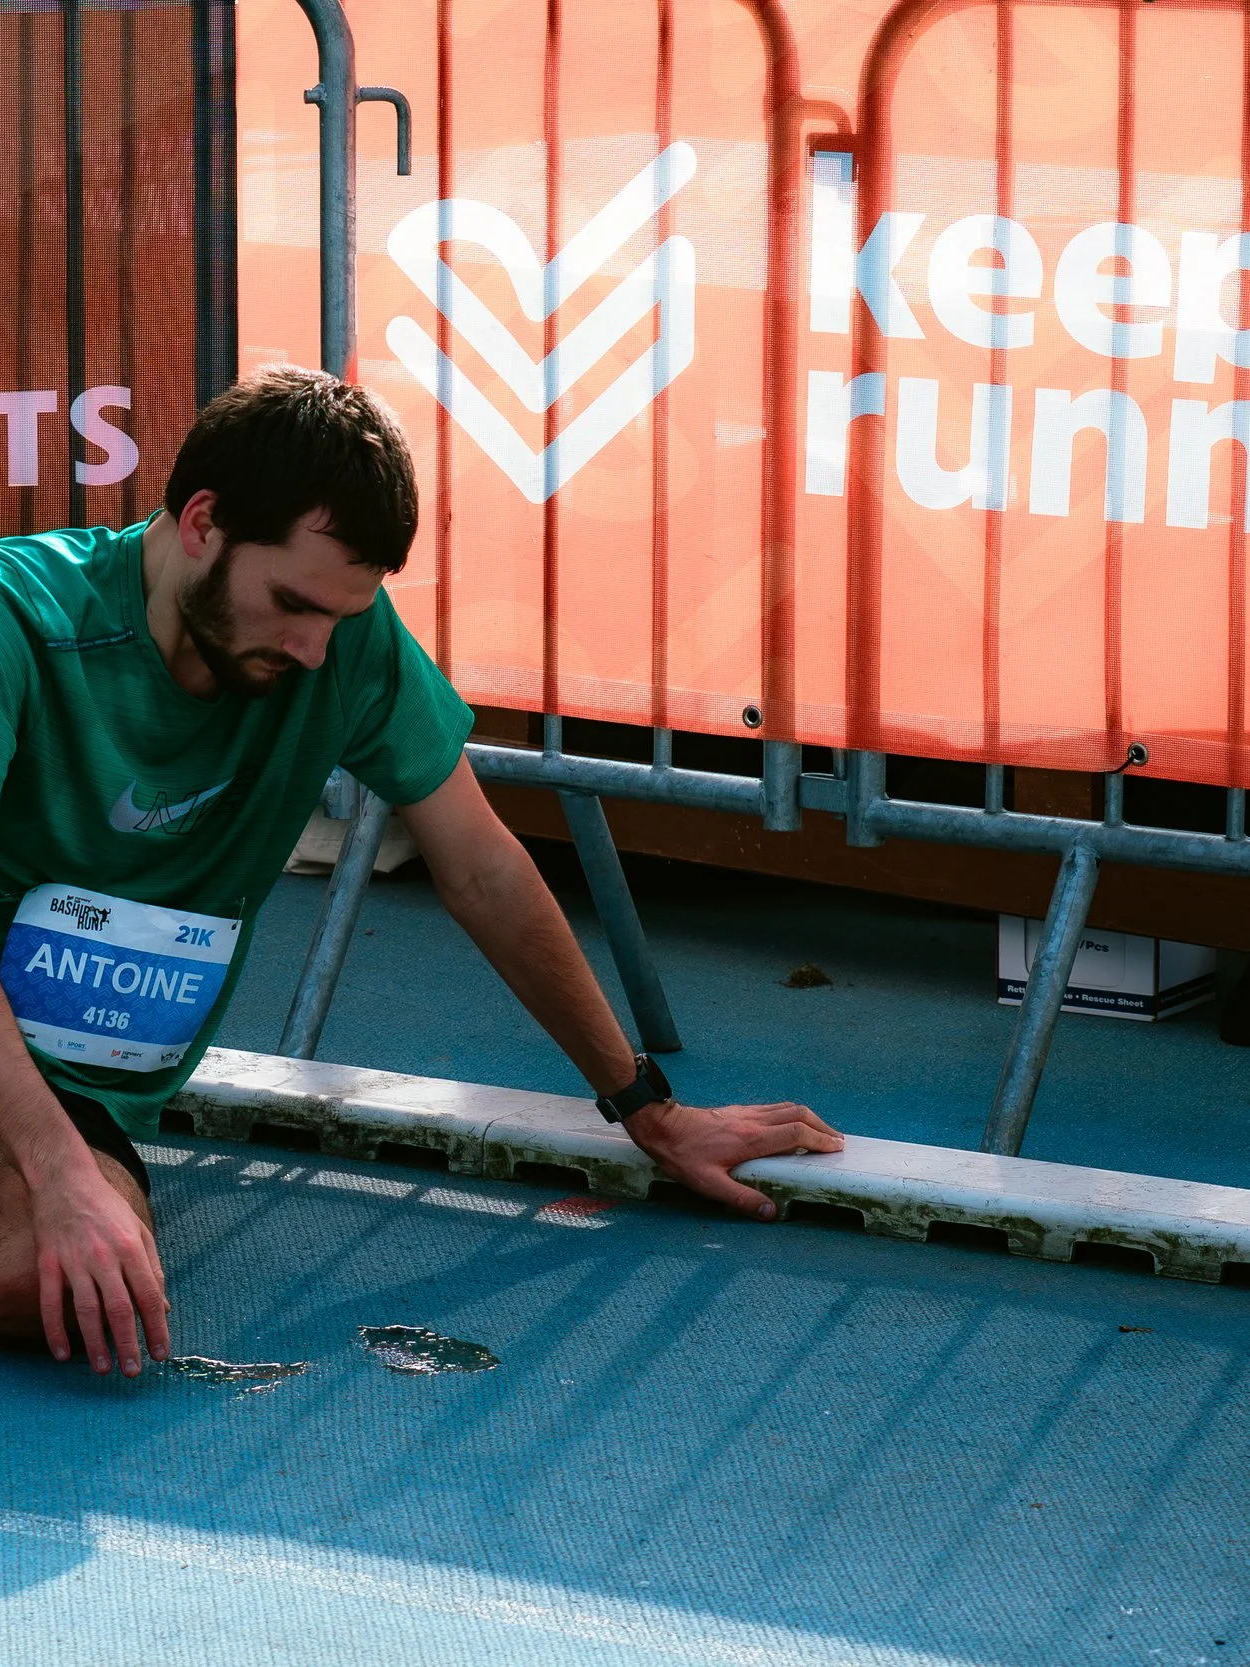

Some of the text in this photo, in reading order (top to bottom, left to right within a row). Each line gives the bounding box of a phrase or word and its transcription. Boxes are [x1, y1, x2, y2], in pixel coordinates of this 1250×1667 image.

[809, 151, 1250, 384] keep
[805, 370, 1250, 532] runn
[175, 925, 216, 947] 21K
[25, 943, 203, 1004] ANTOINE
[82, 1007, 130, 1030] 4136
[1082, 994, 1115, 1005] Rescue
[1117, 998, 1144, 1008] Sheet
